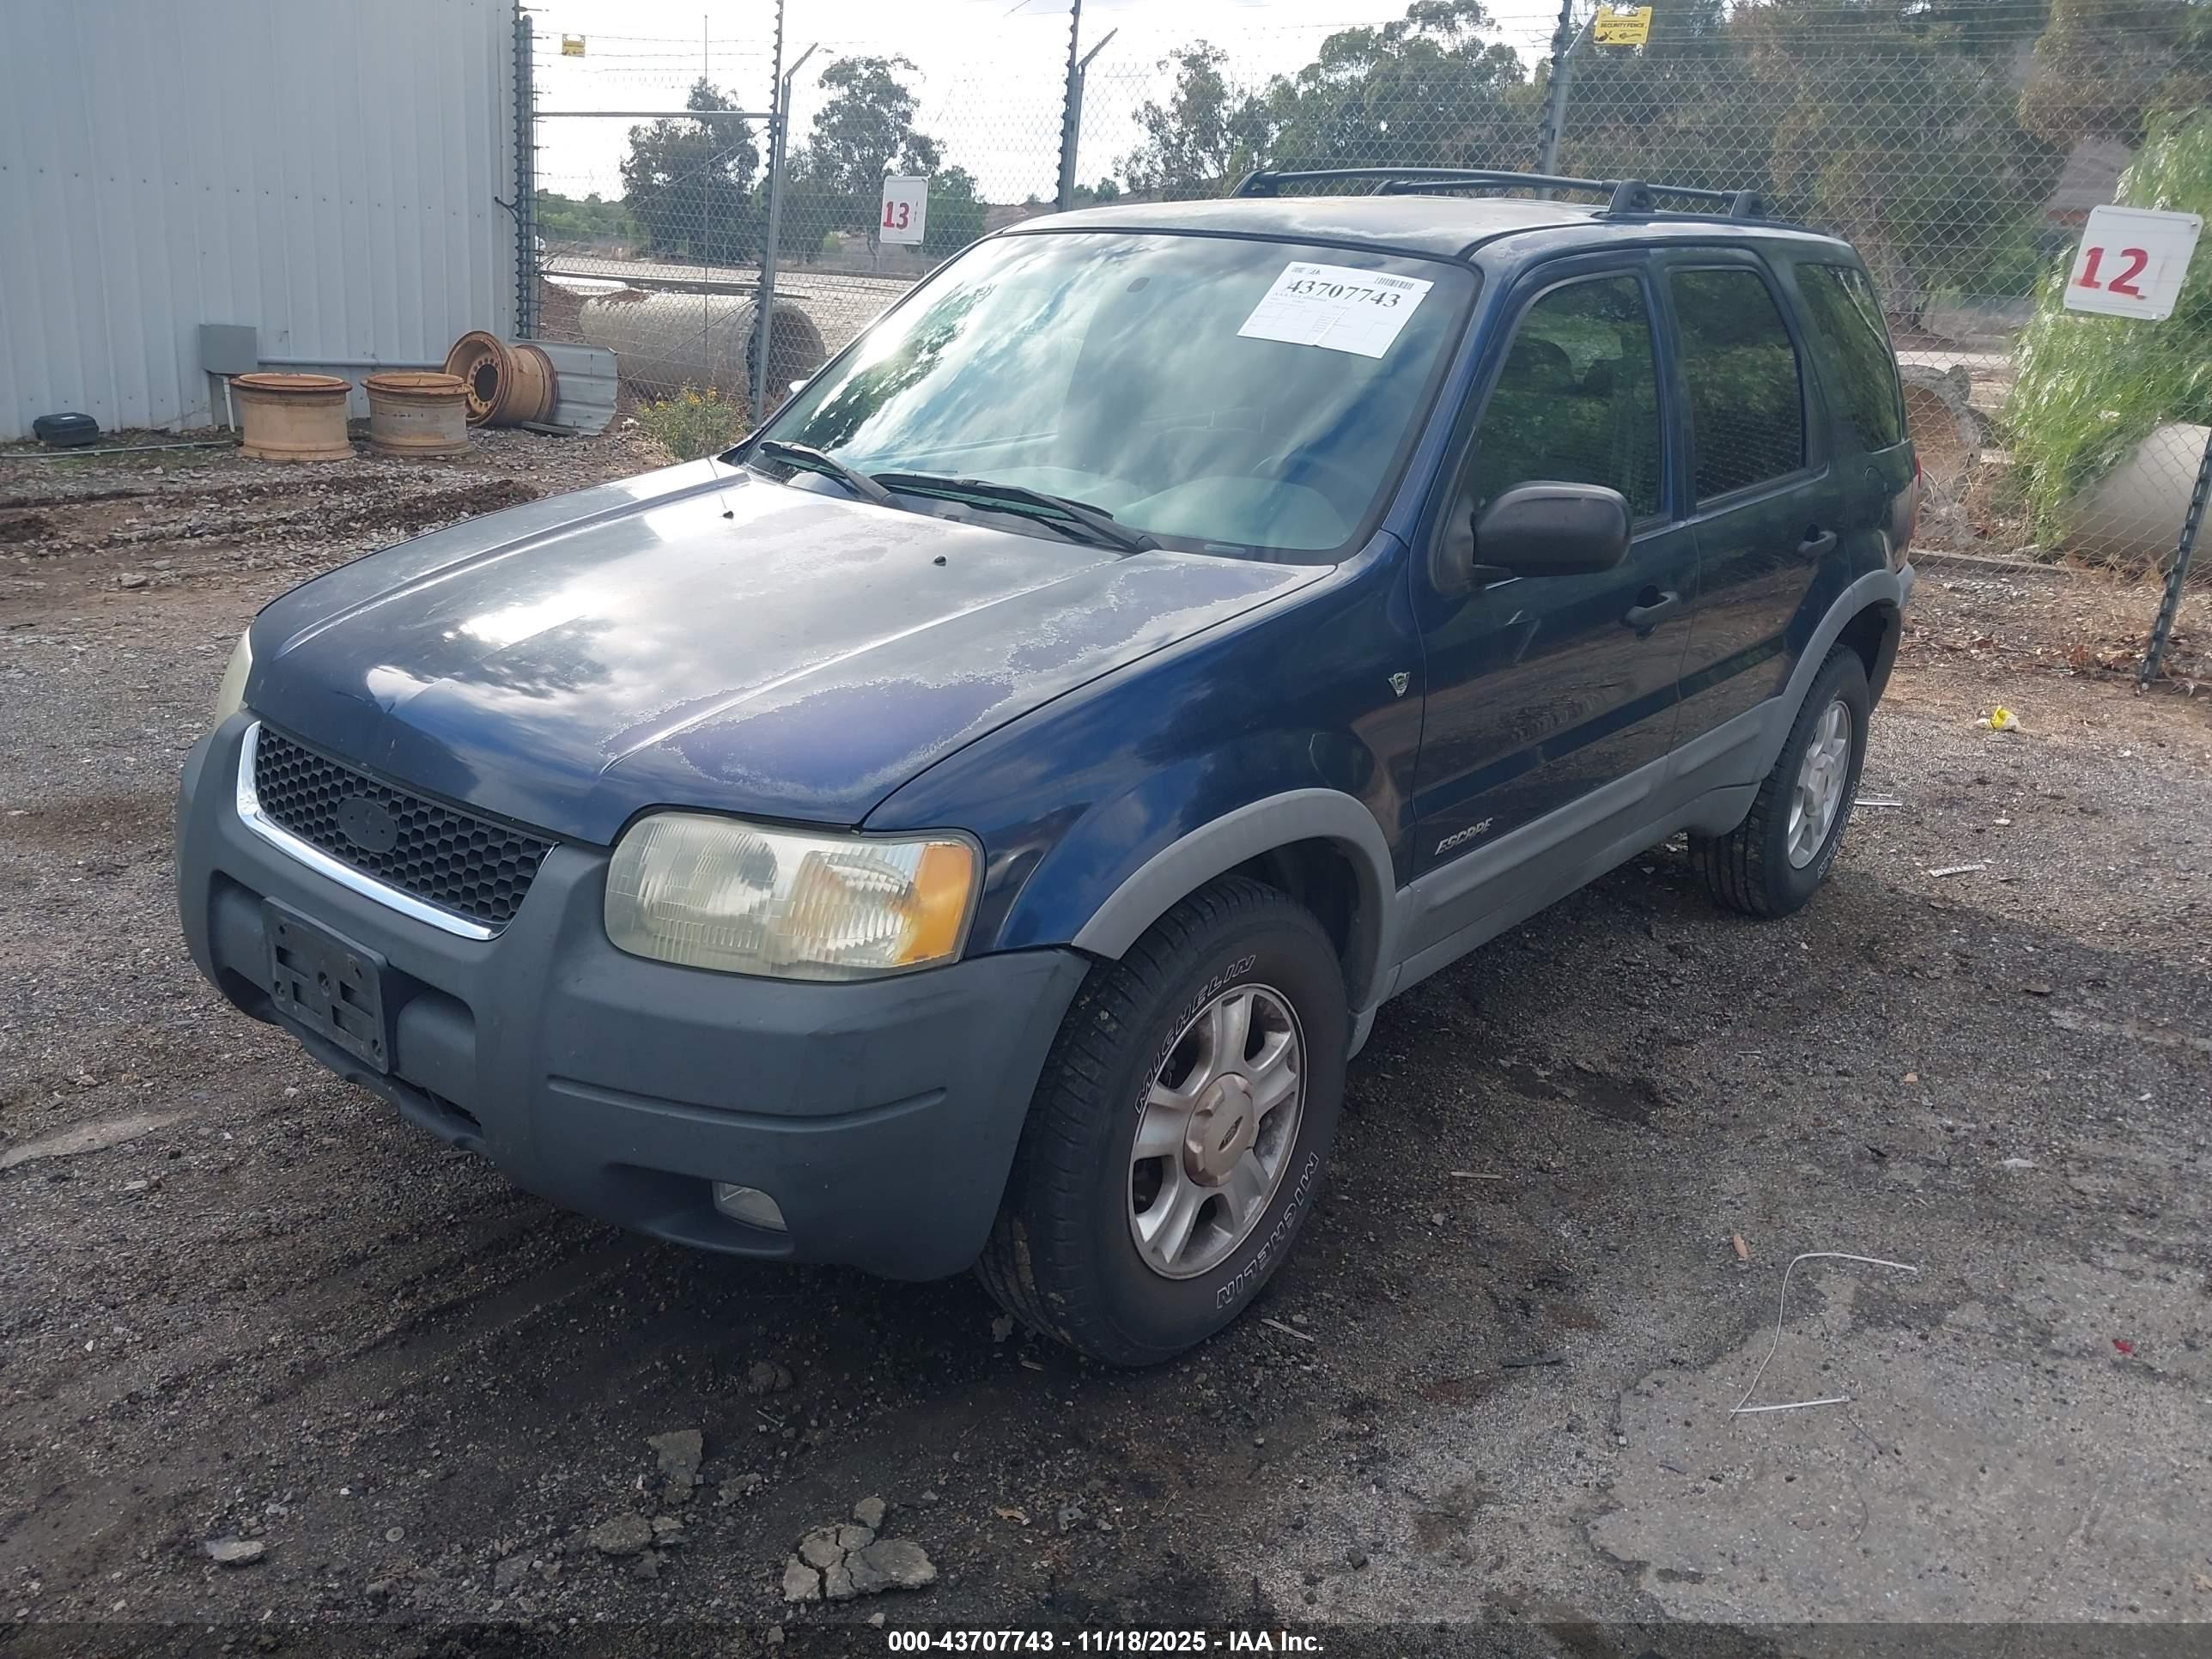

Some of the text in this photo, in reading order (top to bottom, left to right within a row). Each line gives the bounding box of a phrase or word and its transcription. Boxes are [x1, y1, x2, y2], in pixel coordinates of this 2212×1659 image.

[883, 201, 910, 230] 13
[1286, 279, 1401, 308] 43707743
[2073, 246, 2148, 297] 12
[1434, 817, 1494, 856] ESCAPE
[1134, 955, 1256, 1114] MICHELIN
[1216, 1151, 1320, 1310] MICHELIN
